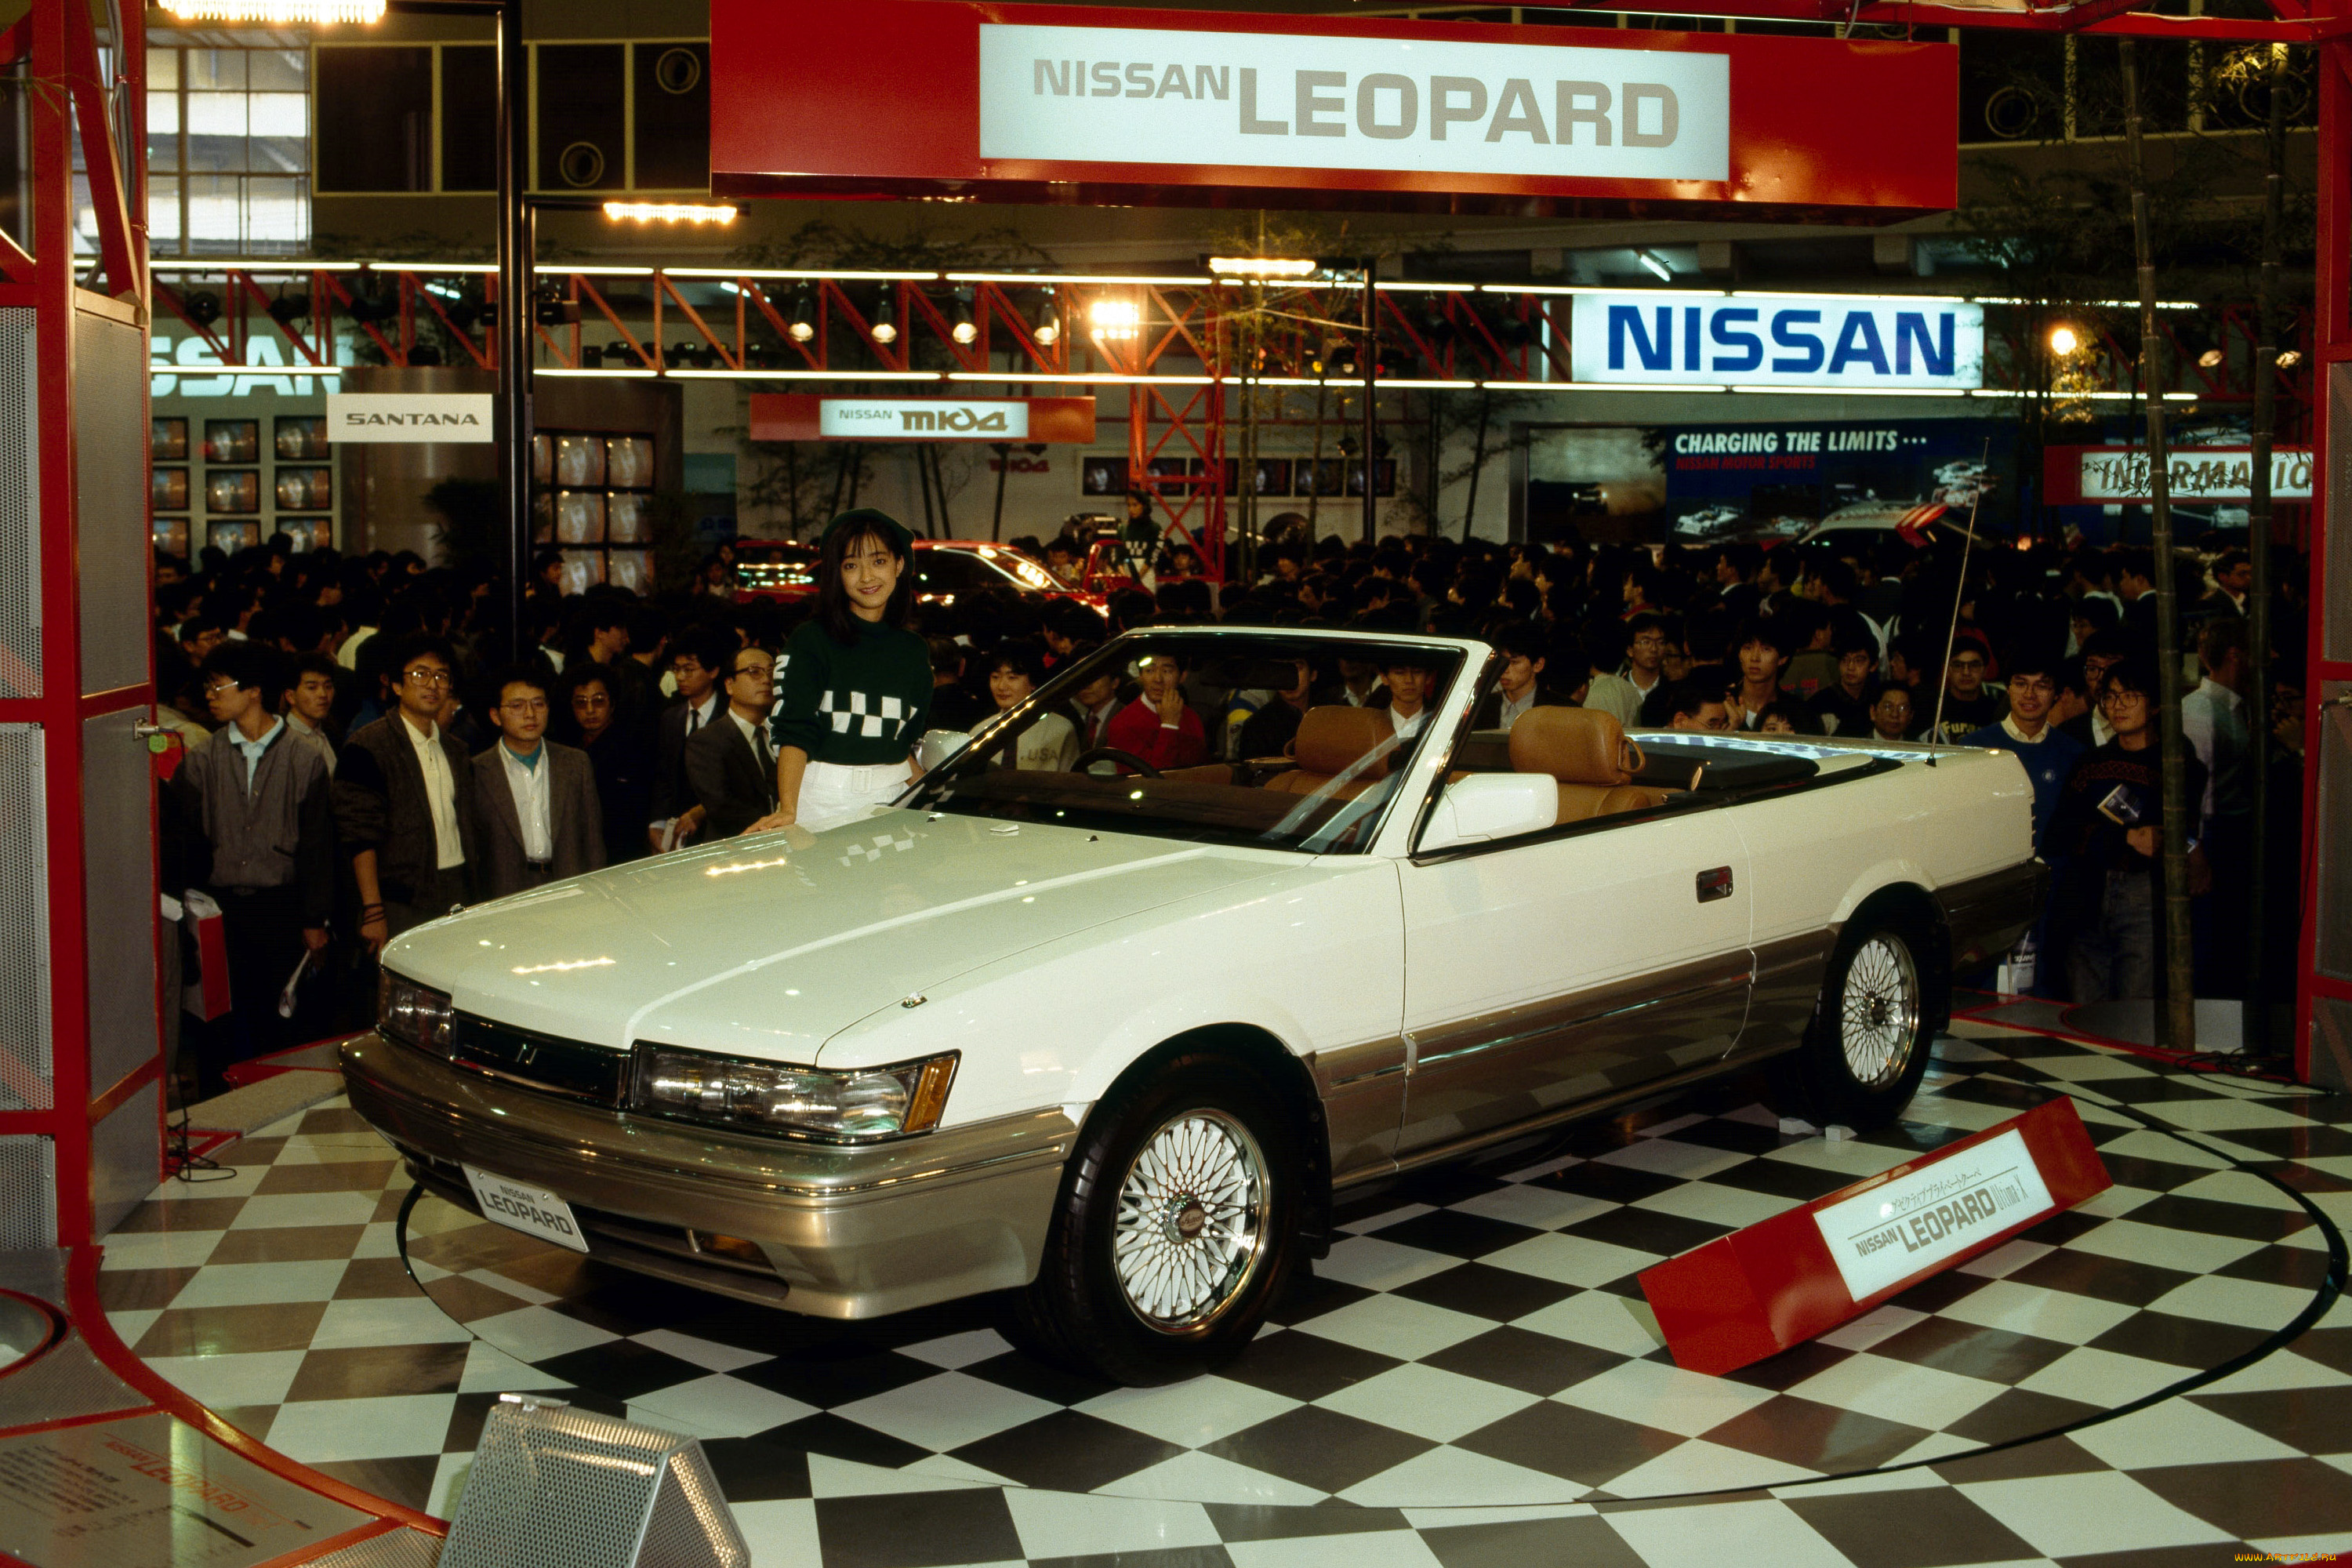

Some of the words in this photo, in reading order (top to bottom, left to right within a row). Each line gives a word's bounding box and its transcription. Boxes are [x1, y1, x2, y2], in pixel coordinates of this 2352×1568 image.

[1033, 57, 1230, 101] NISSAN
[1239, 66, 1679, 149] LEOPARD
[1607, 305, 1955, 376] NISSAN
[346, 412, 480, 426] SANTANA
[839, 408, 893, 420] NISSAN
[1675, 433, 1779, 454] CHARGING
[1785, 432, 1821, 452] THE
[1675, 456, 1720, 471] NISSAN
[1722, 456, 1765, 470] MOTOR
[1769, 454, 1816, 470] SPORTS
[2100, 460, 2314, 489] INFRMAIO
[499, 1185, 535, 1204] NISSAN
[479, 1189, 573, 1236] LEOPARD
[1855, 1228, 1898, 1258] NISSAN
[1896, 1188, 1997, 1253] LEOPARD
